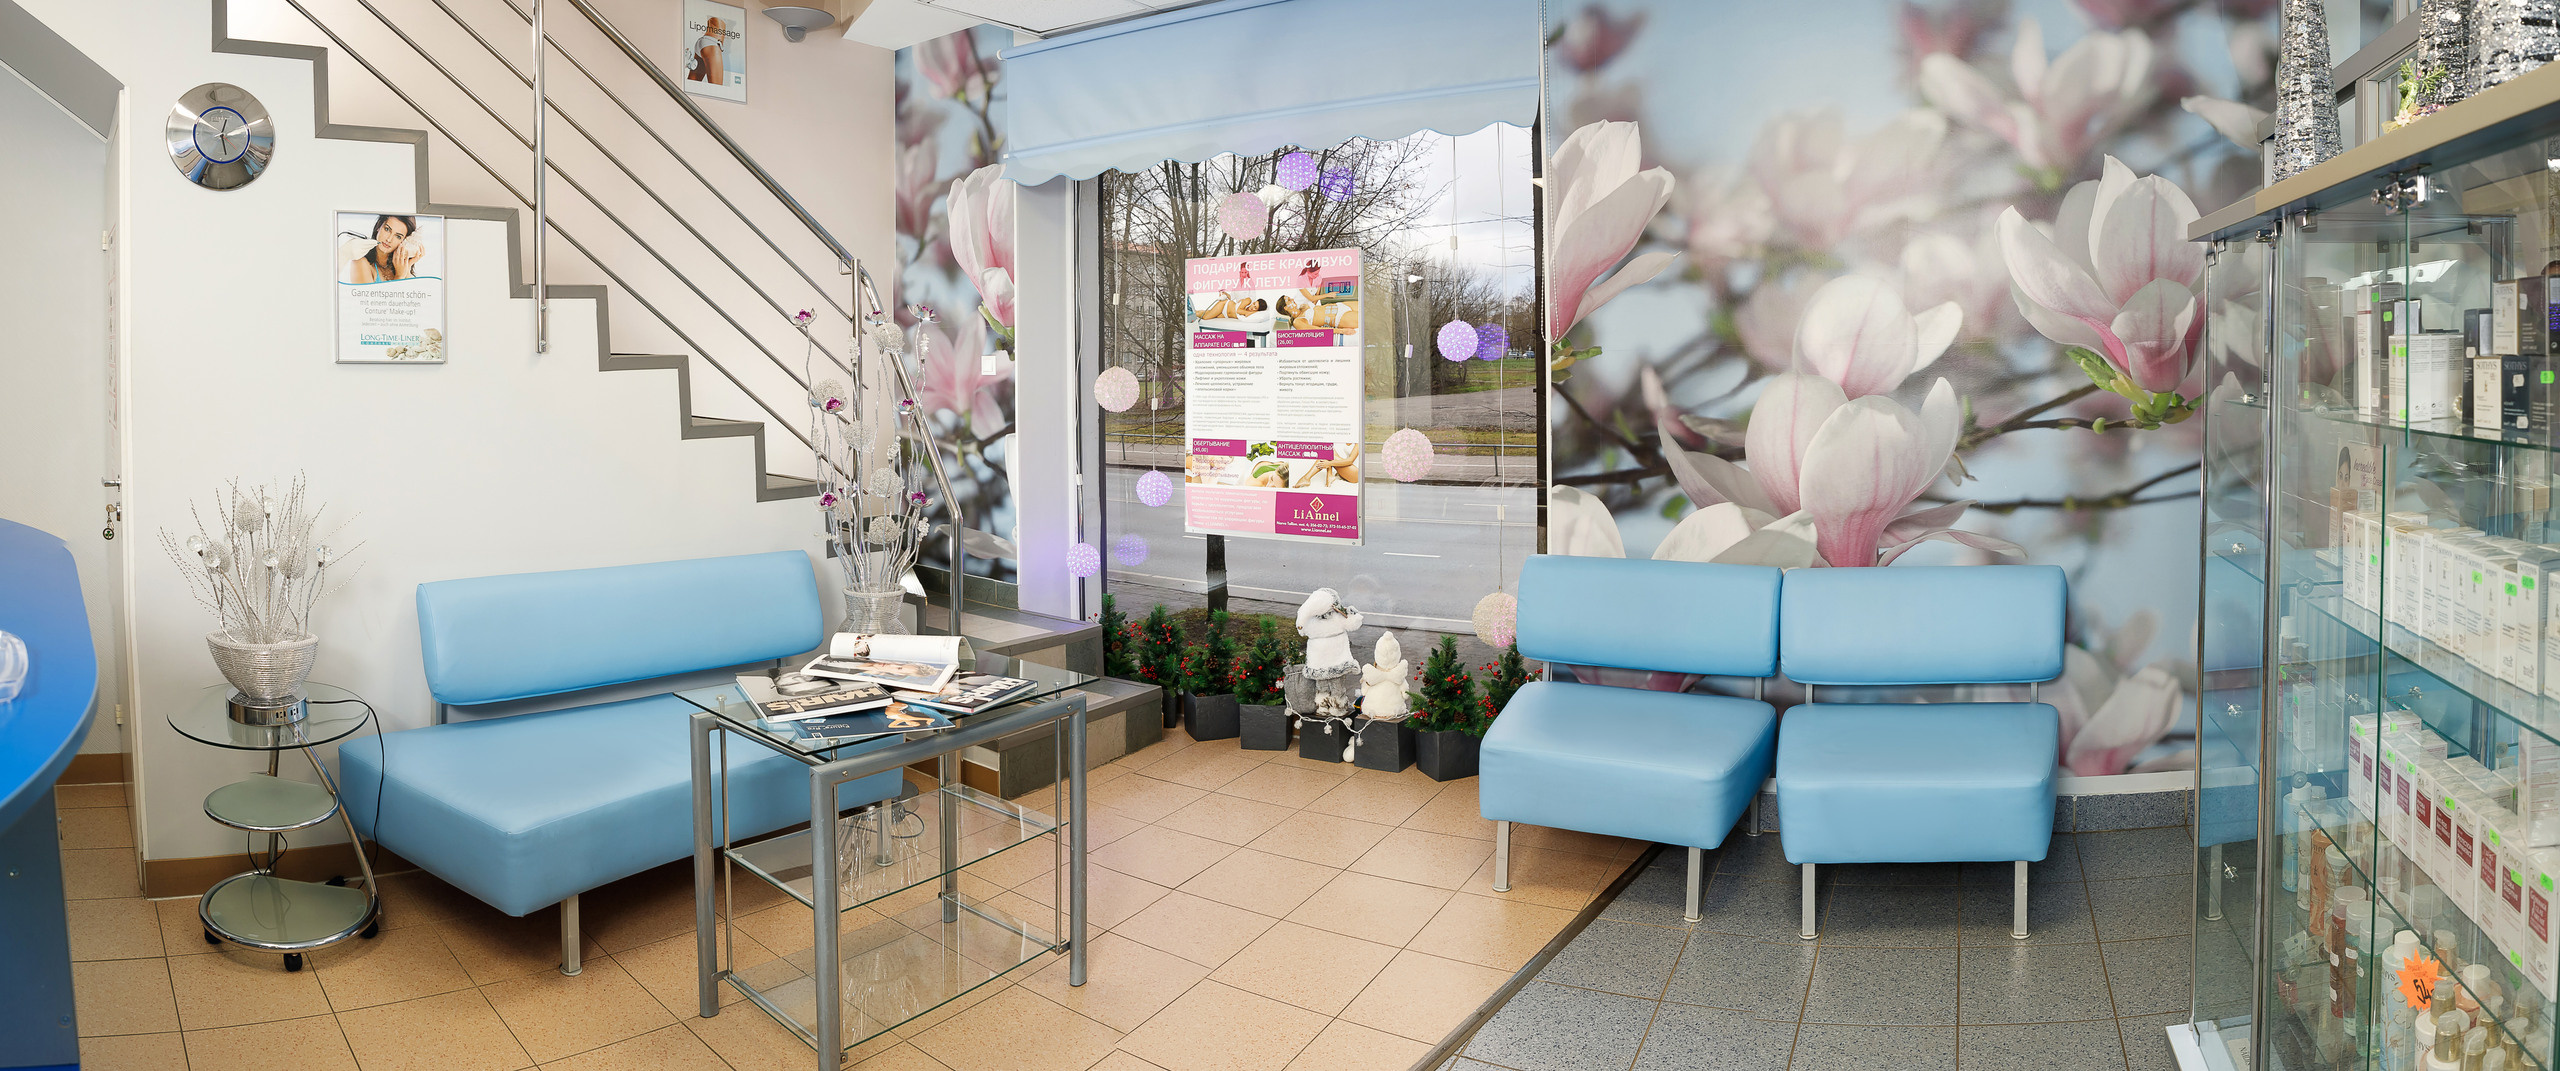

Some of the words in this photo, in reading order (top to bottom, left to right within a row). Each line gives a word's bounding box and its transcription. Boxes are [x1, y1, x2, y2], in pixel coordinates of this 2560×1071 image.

[690, 21, 740, 39] Lipomassage
[1193, 264, 1241, 275] ПОДАРИ
[1245, 260, 1275, 270] СЕБЕ
[1280, 256, 1352, 270] КРАСИВУЮ
[1193, 278, 1240, 290] ФИГУРУ
[1244, 278, 1251, 288] К
[1255, 277, 1291, 287] ЛЕТУ!
[352, 288, 369, 297] Ganz
[370, 290, 404, 299] entspannt
[406, 290, 426, 298] schön
[2475, 361, 2497, 370] SOTHYS
[2504, 361, 2527, 370] SOTHYS
[1294, 509, 1339, 522] LiAnnel
